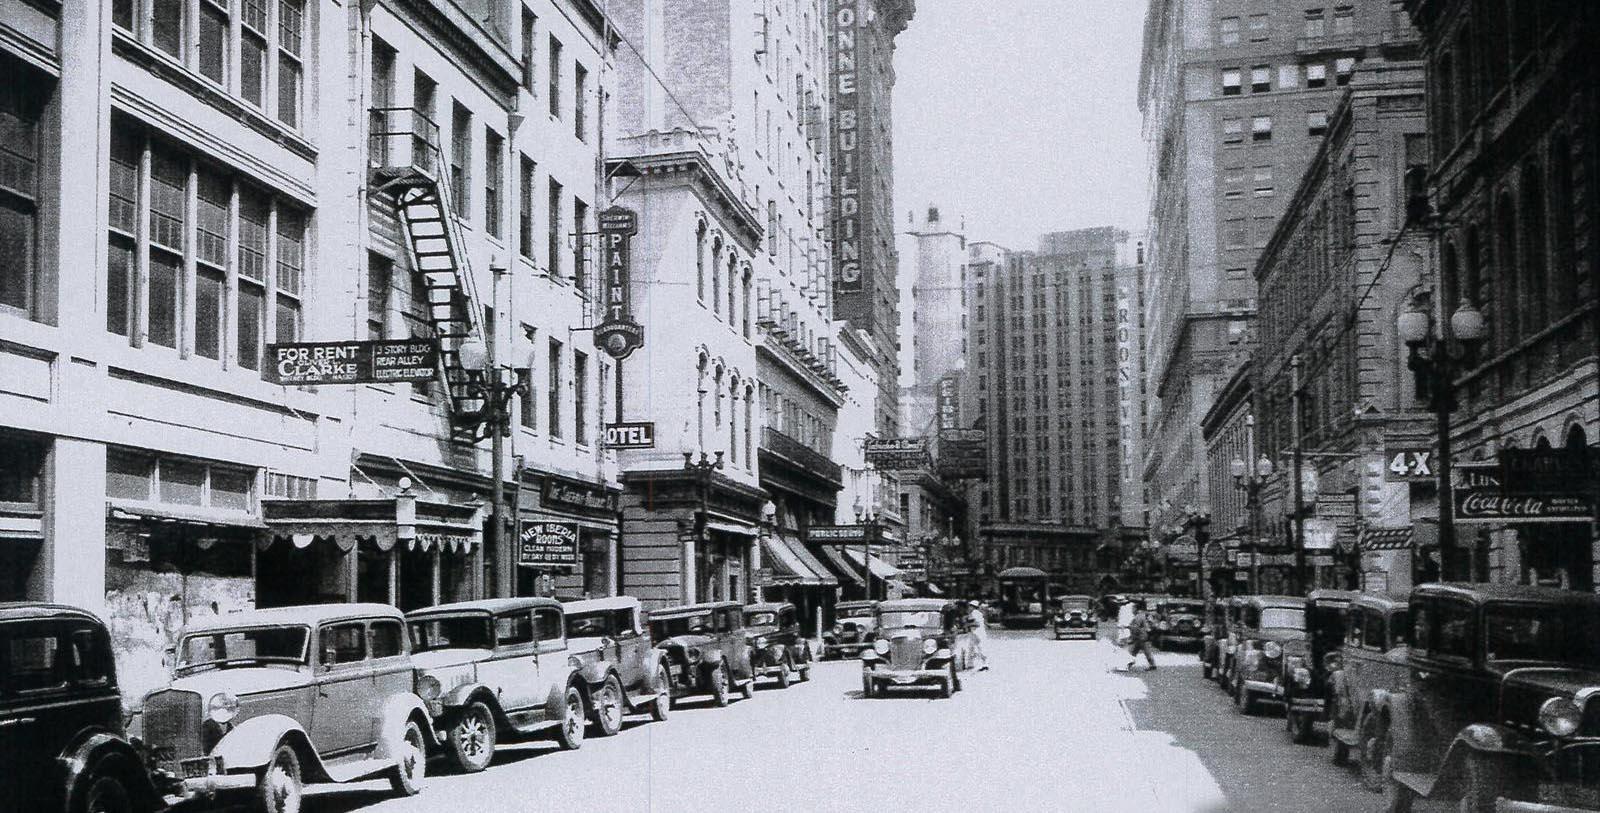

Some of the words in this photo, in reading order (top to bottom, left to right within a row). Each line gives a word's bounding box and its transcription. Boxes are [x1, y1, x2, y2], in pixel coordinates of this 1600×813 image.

[837, 0, 857, 94] ONNE
[839, 109, 861, 282] BUILDING
[611, 233, 622, 320] PAINT
[277, 347, 309, 361] FOR
[313, 345, 360, 360] RENT
[376, 345, 383, 355] 3
[384, 344, 407, 355] STORY
[410, 343, 431, 353] BLDG
[277, 359, 358, 377] CLARKE
[376, 356, 397, 366] REAR
[397, 355, 425, 365] ALLEY
[376, 369, 403, 379] ELECTRIC
[403, 367, 434, 378] ELEVATOR
[607, 427, 652, 444] OTEL
[1389, 451, 1431, 476] 4-X
[521, 524, 543, 541] NEW
[546, 523, 577, 543] IBERIA
[536, 534, 564, 545] ROOMS
[809, 530, 838, 538] PUBLIC
[523, 544, 544, 552] CLEAN
